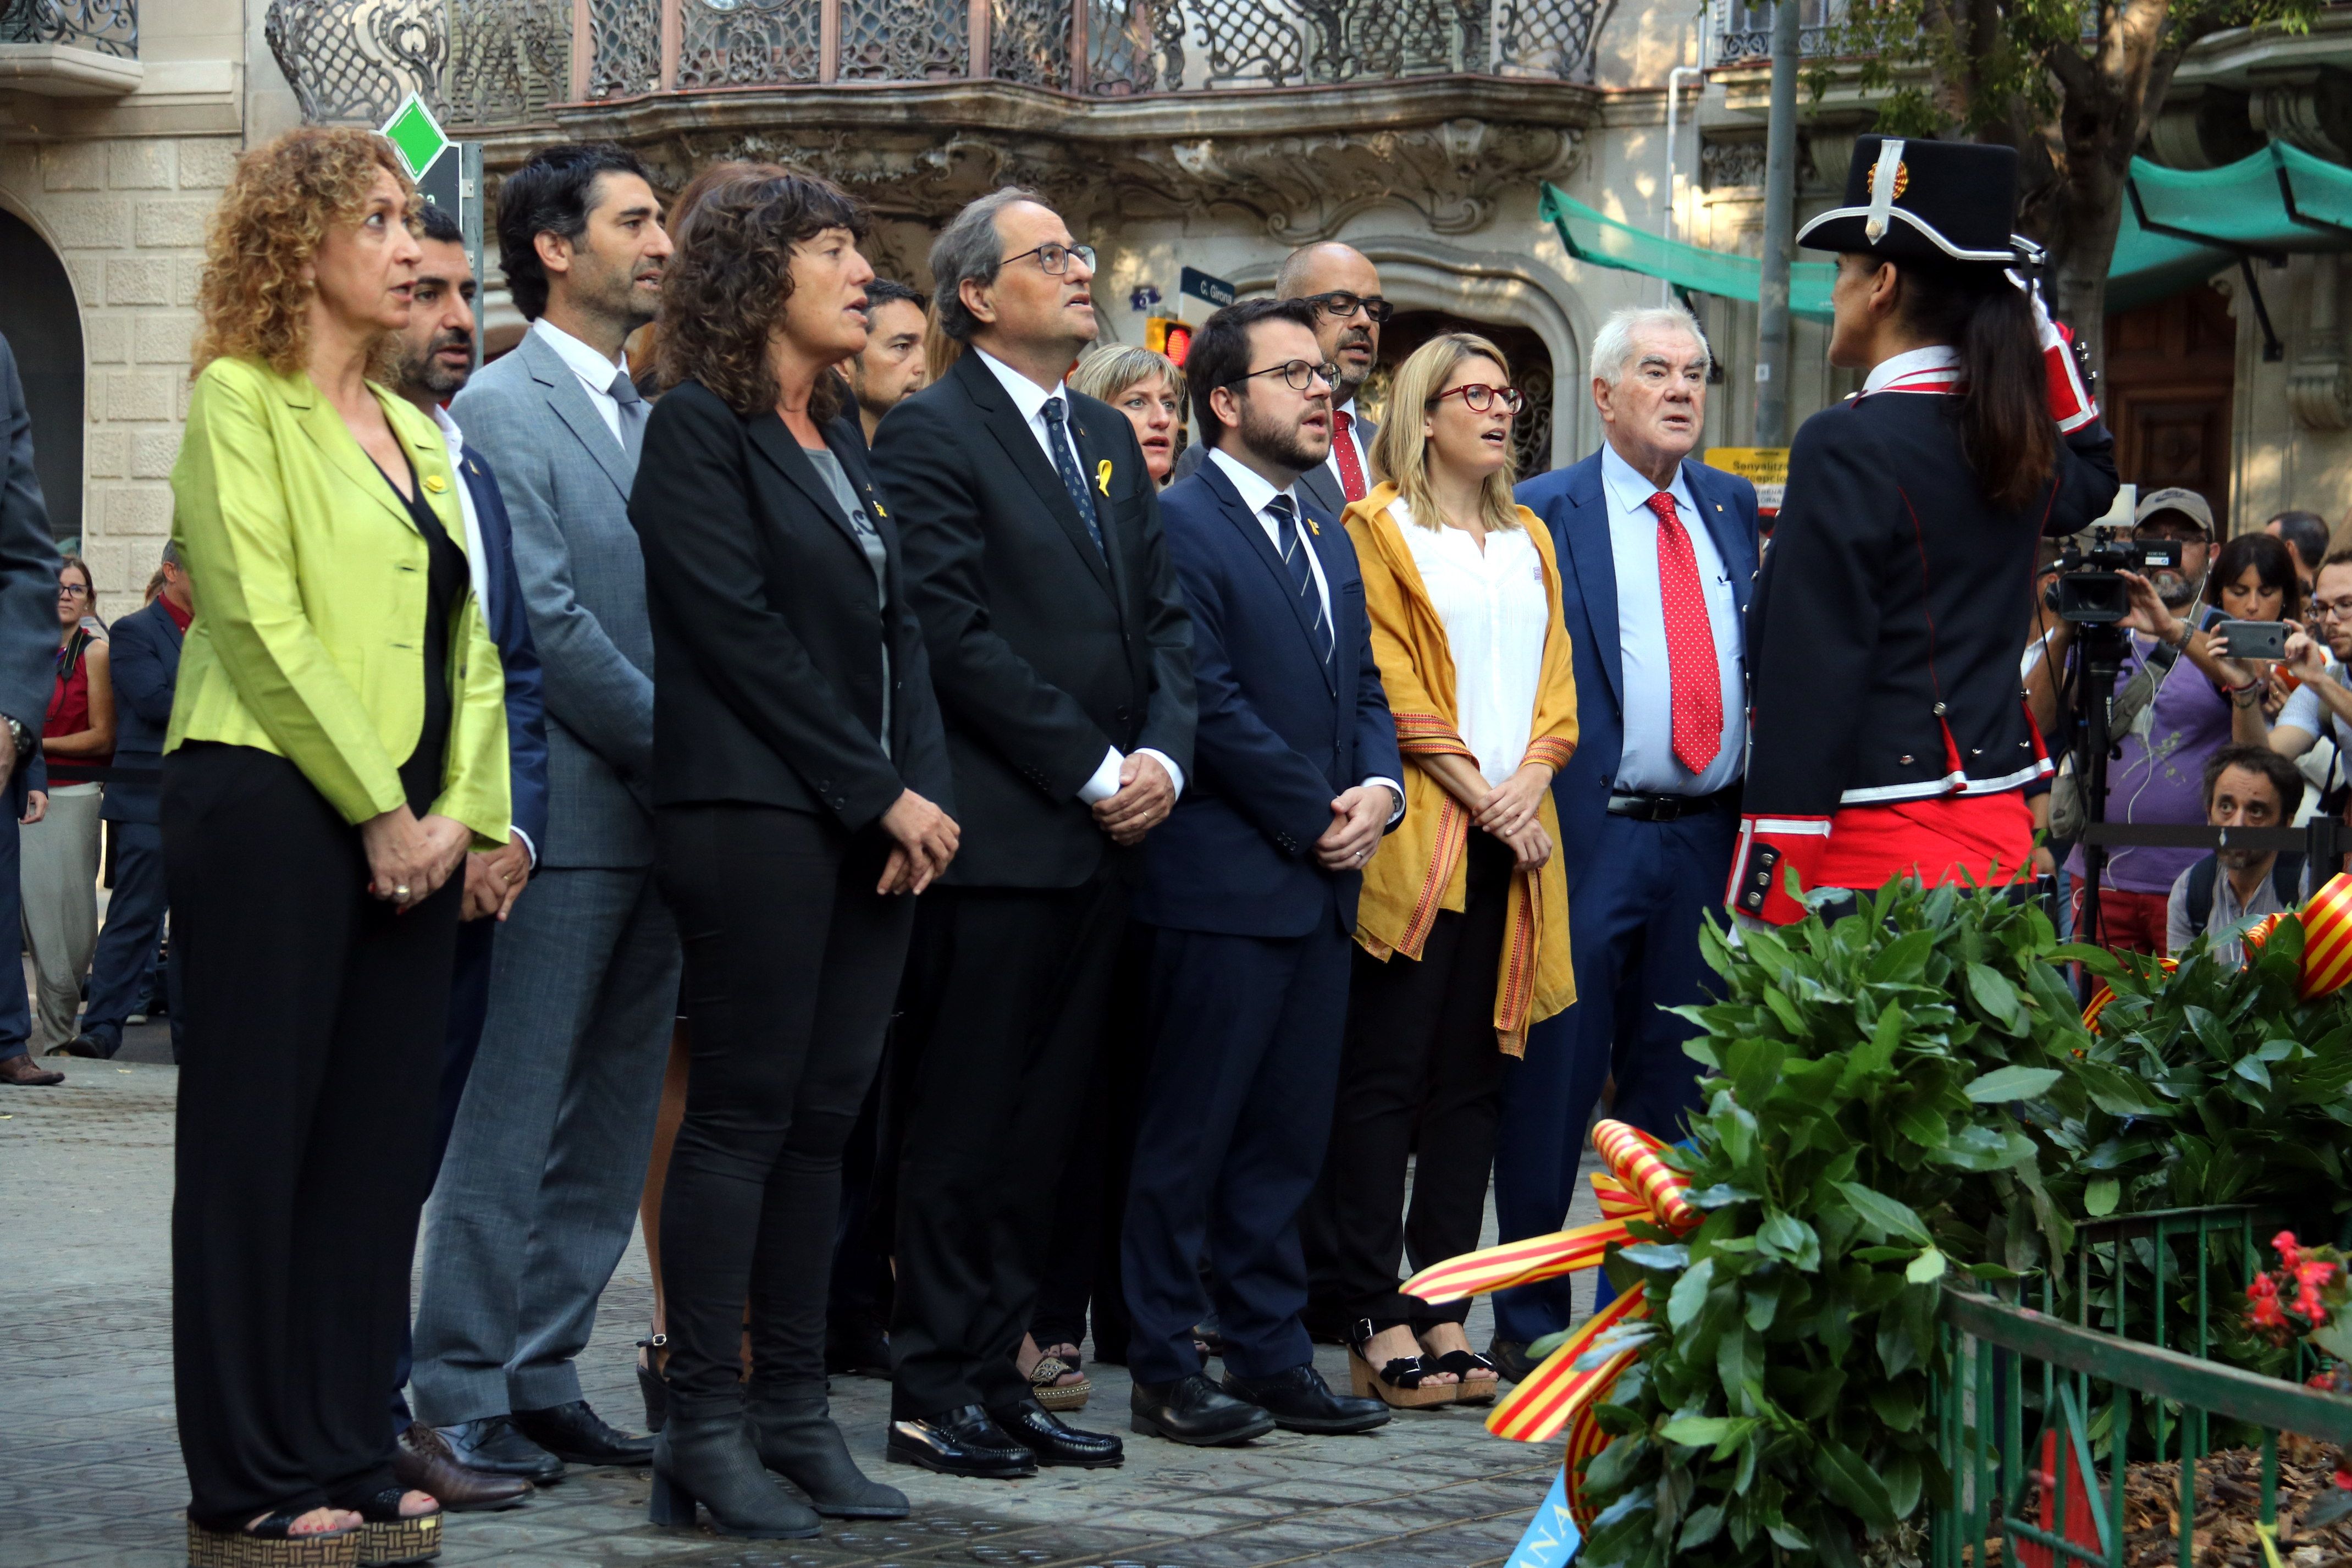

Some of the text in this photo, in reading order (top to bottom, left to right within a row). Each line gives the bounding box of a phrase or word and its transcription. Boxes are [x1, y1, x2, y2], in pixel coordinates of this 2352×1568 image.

[1200, 280, 1232, 304] C. Girona
[1519, 1504, 1573, 1568] NA
